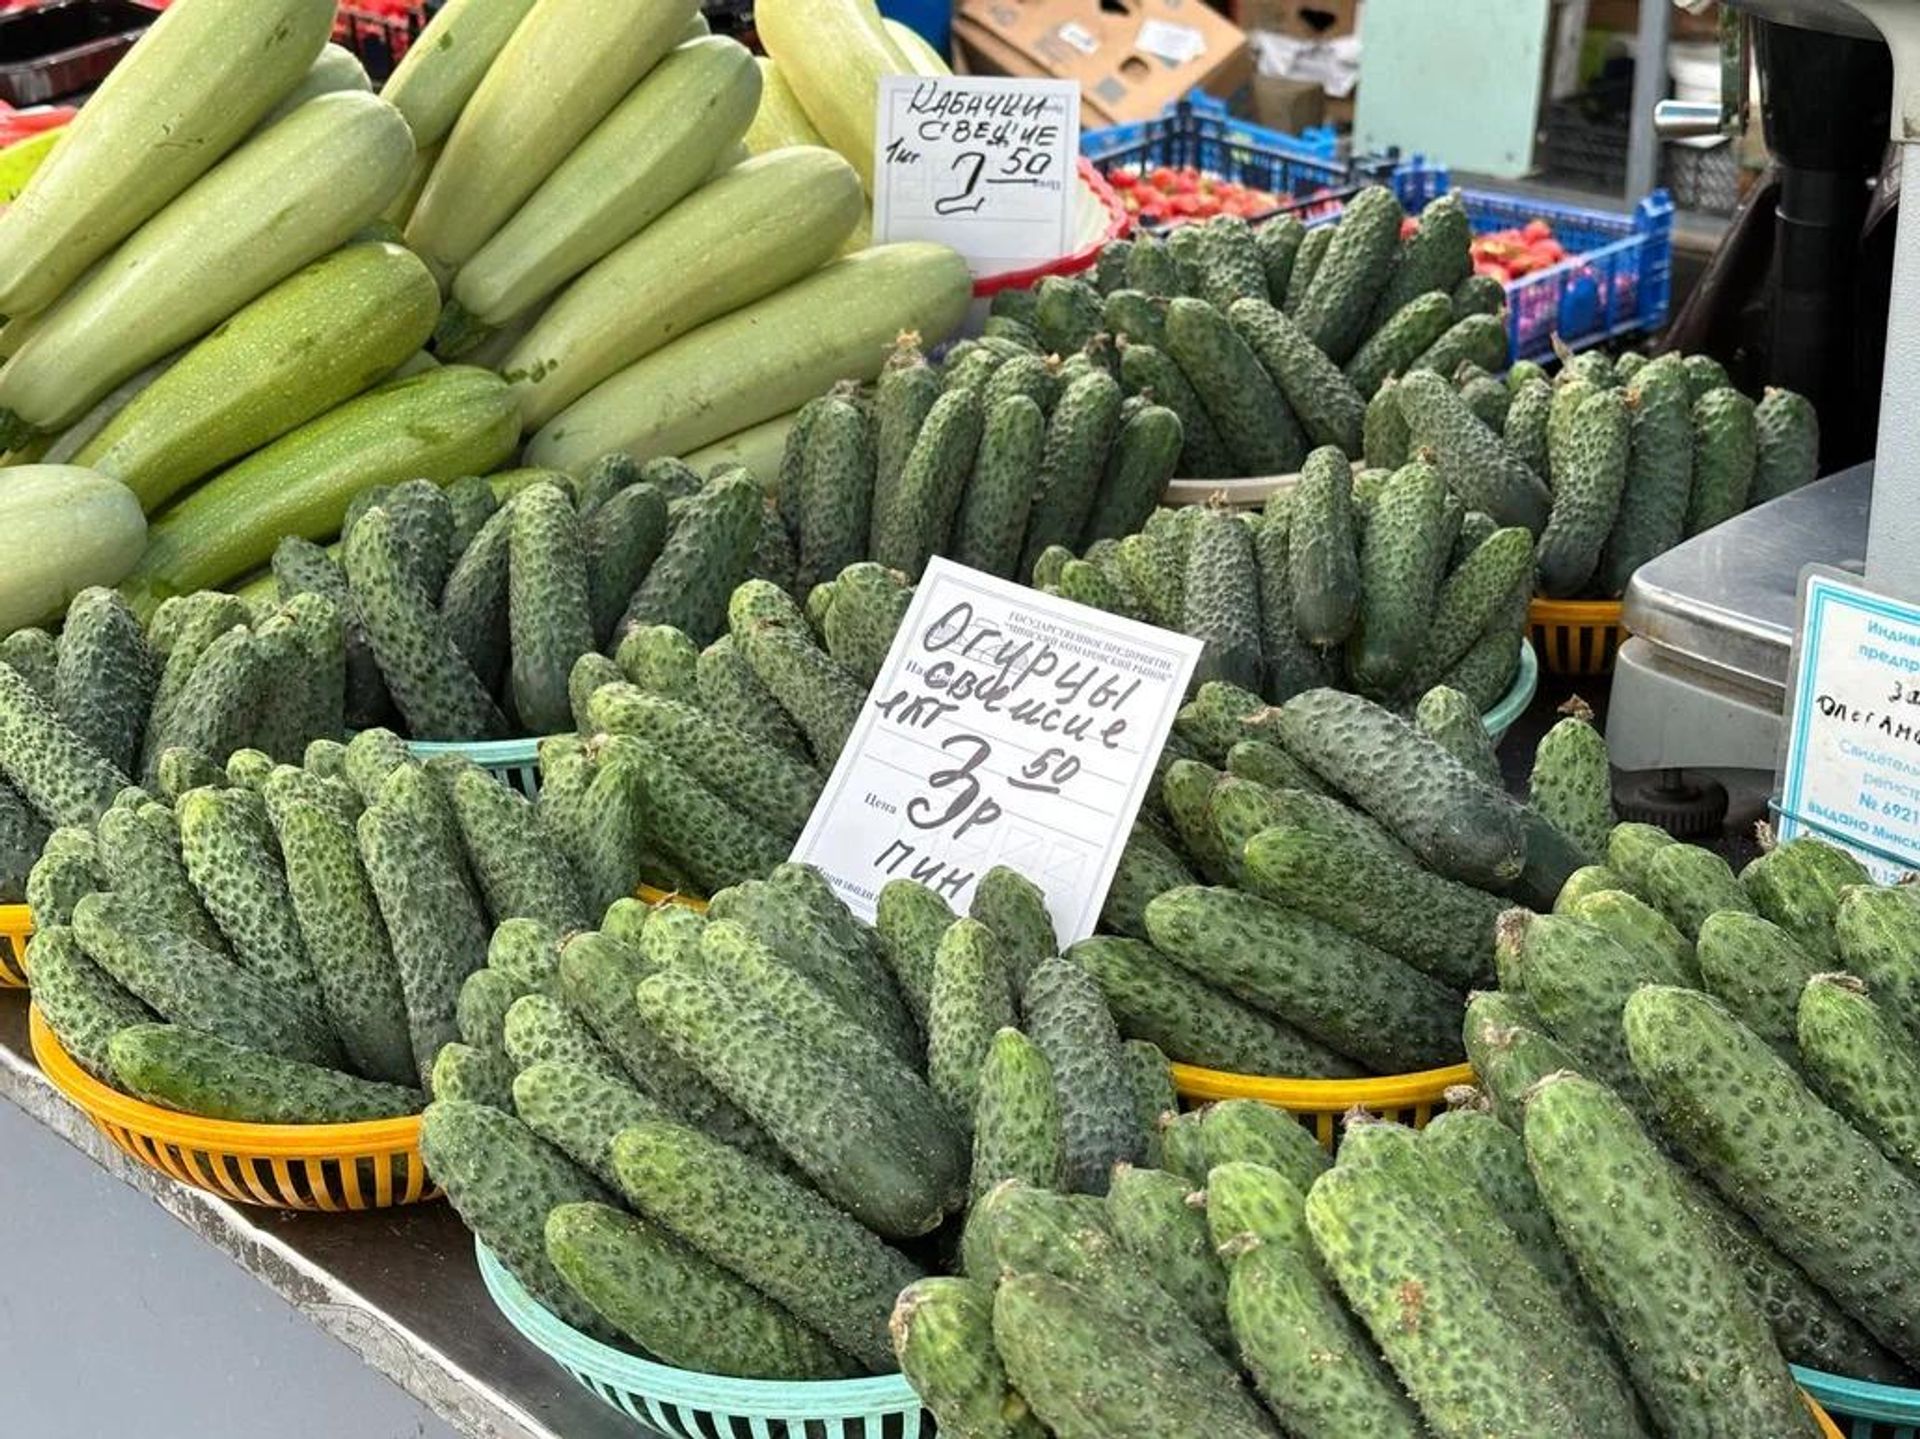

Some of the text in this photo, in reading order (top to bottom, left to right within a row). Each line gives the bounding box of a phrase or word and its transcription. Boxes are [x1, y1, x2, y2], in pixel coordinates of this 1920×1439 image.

[1001, 147, 1052, 175] 50
[922, 601, 1141, 712] Огурцы
[1021, 746, 1081, 785] 50
[863, 791, 898, 816] Цена
